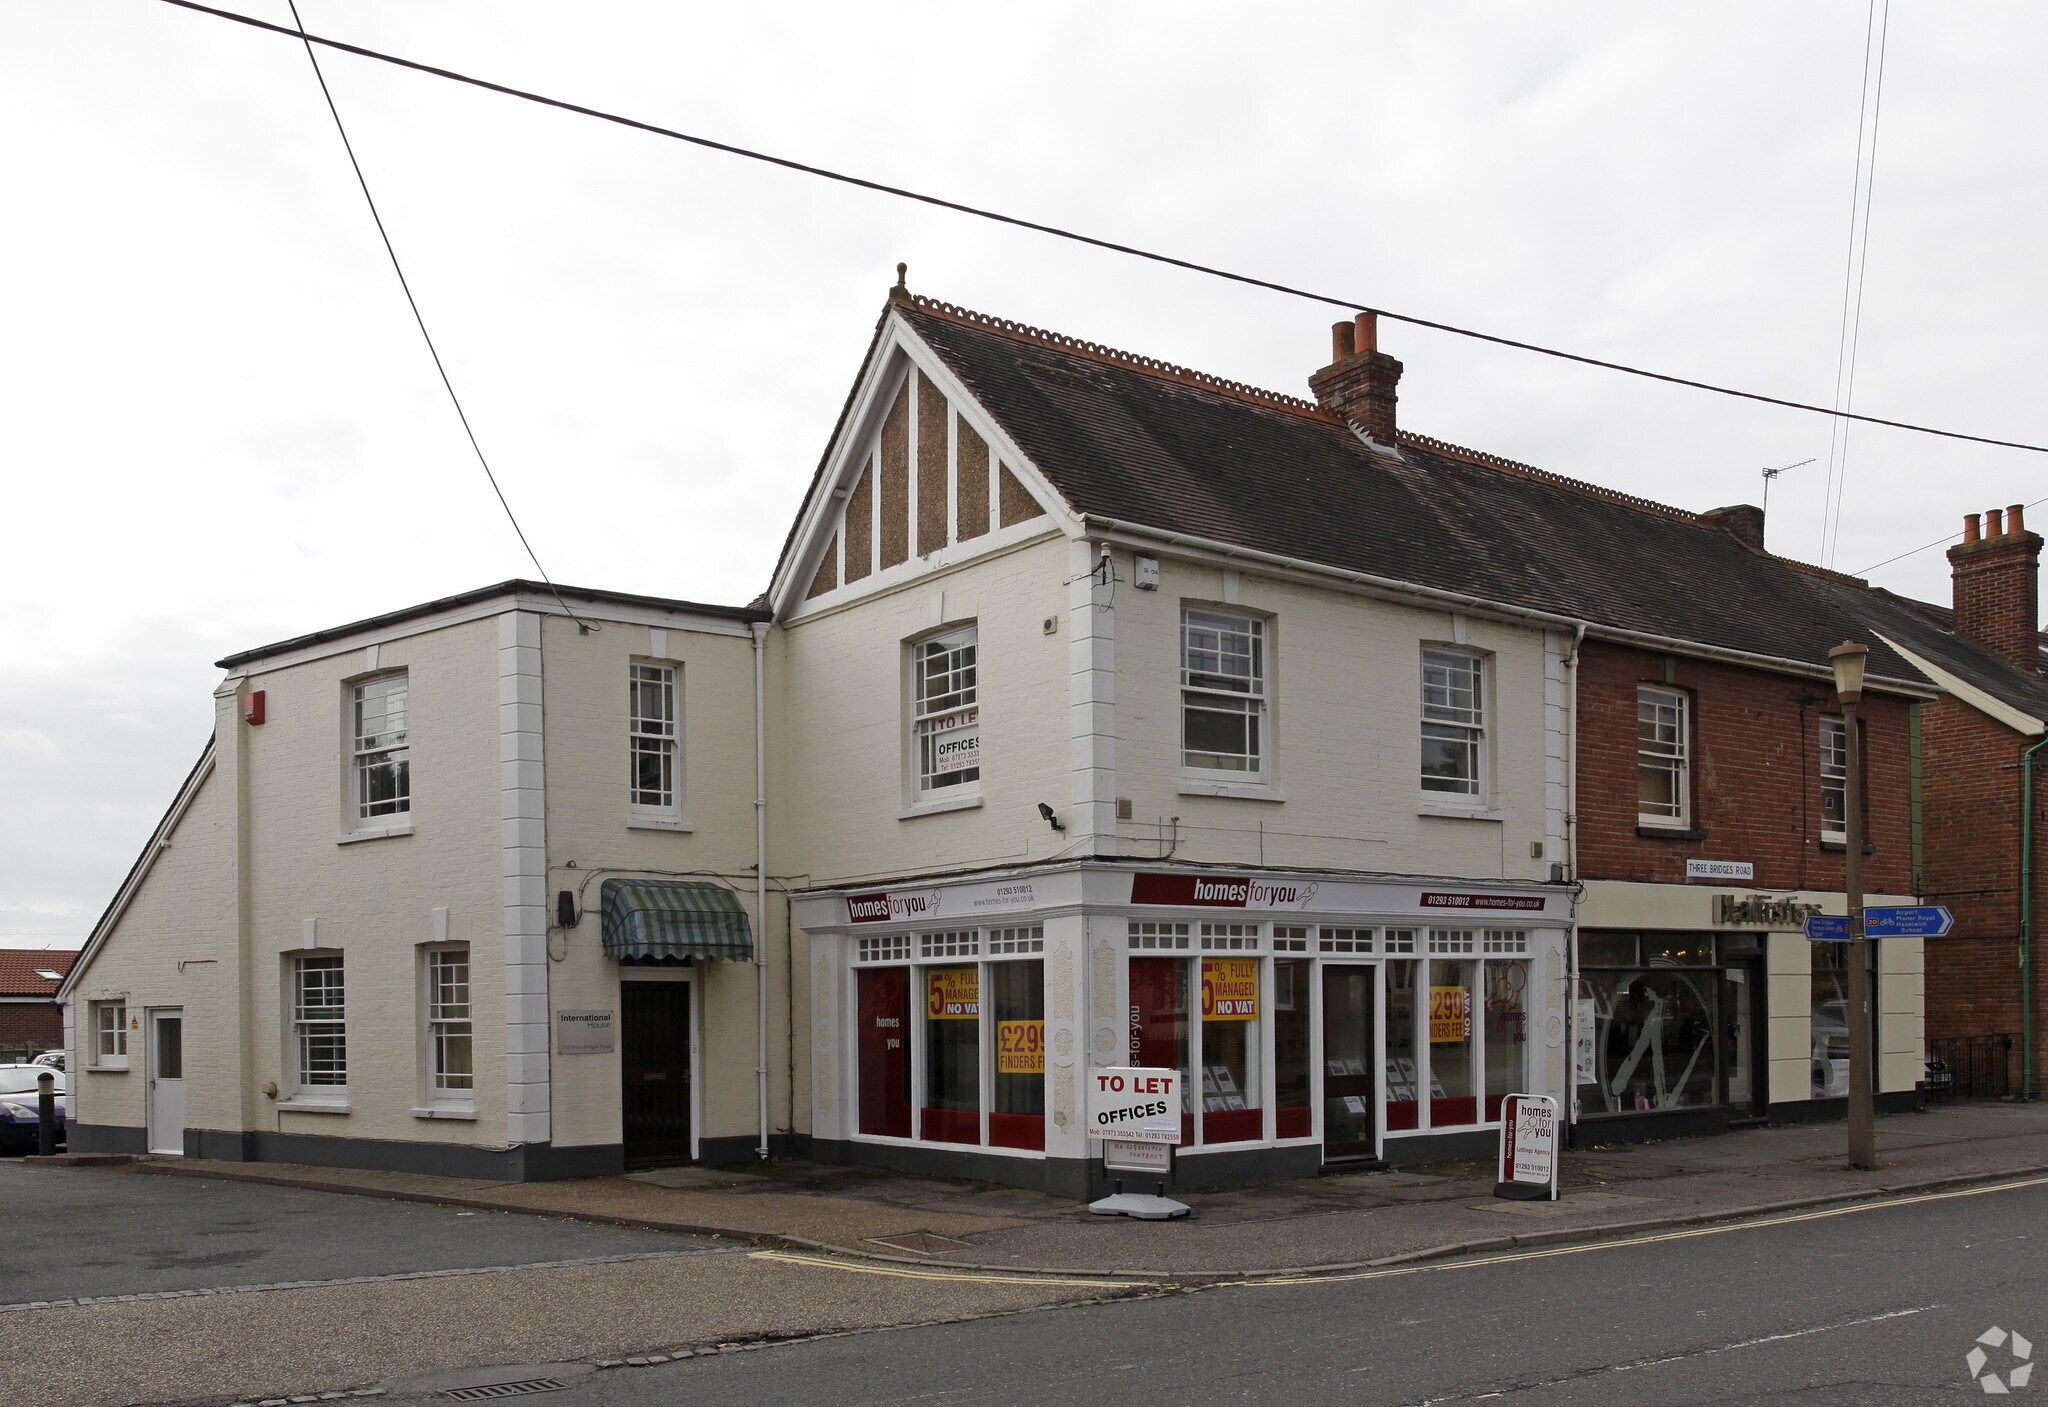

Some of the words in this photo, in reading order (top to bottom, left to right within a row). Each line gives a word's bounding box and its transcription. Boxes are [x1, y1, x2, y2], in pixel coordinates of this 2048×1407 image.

[938, 716, 955, 730] TO
[961, 709, 979, 725] LE
[1689, 863, 1707, 873] THREE
[1710, 864, 1733, 875] BRIDGES
[1736, 866, 1751, 876] ROAD
[996, 886, 1012, 896] 01293
[1013, 885, 1032, 894] 510012
[973, 895, 1034, 906] www.homes-for-you.co.uk
[1428, 895, 1447, 905] 01293
[1448, 897, 1470, 906] 510012
[1475, 898, 1540, 908] www.homes-for-you.co.uk
[1231, 963, 1254, 978] FULLY
[1215, 982, 1255, 996] MANAGED
[947, 1003, 962, 1014] NO
[964, 1003, 979, 1014] VA
[1217, 1001, 1232, 1014] NO
[1235, 1000, 1254, 1013] VAT
[561, 1014, 611, 1022] International
[876, 1016, 900, 1028] homes
[1452, 1022, 1463, 1037] FEE
[1465, 1018, 1470, 1037] NO
[887, 1038, 900, 1050] you
[1513, 1032, 1526, 1045] you
[1001, 1055, 1035, 1069] FINDERS
[1097, 1076, 1125, 1092] TO
[1134, 1077, 1173, 1094] LET
[1097, 1101, 1167, 1125] OFFICES
[1522, 1105, 1551, 1118] homes
[1539, 1117, 1551, 1128] for
[1535, 1127, 1551, 1138] you
[1516, 1146, 1533, 1154] Lettings
[1534, 1148, 1550, 1156] Agency
[1516, 1162, 1530, 1170] 01293
[1531, 1164, 1549, 1172] 510012
